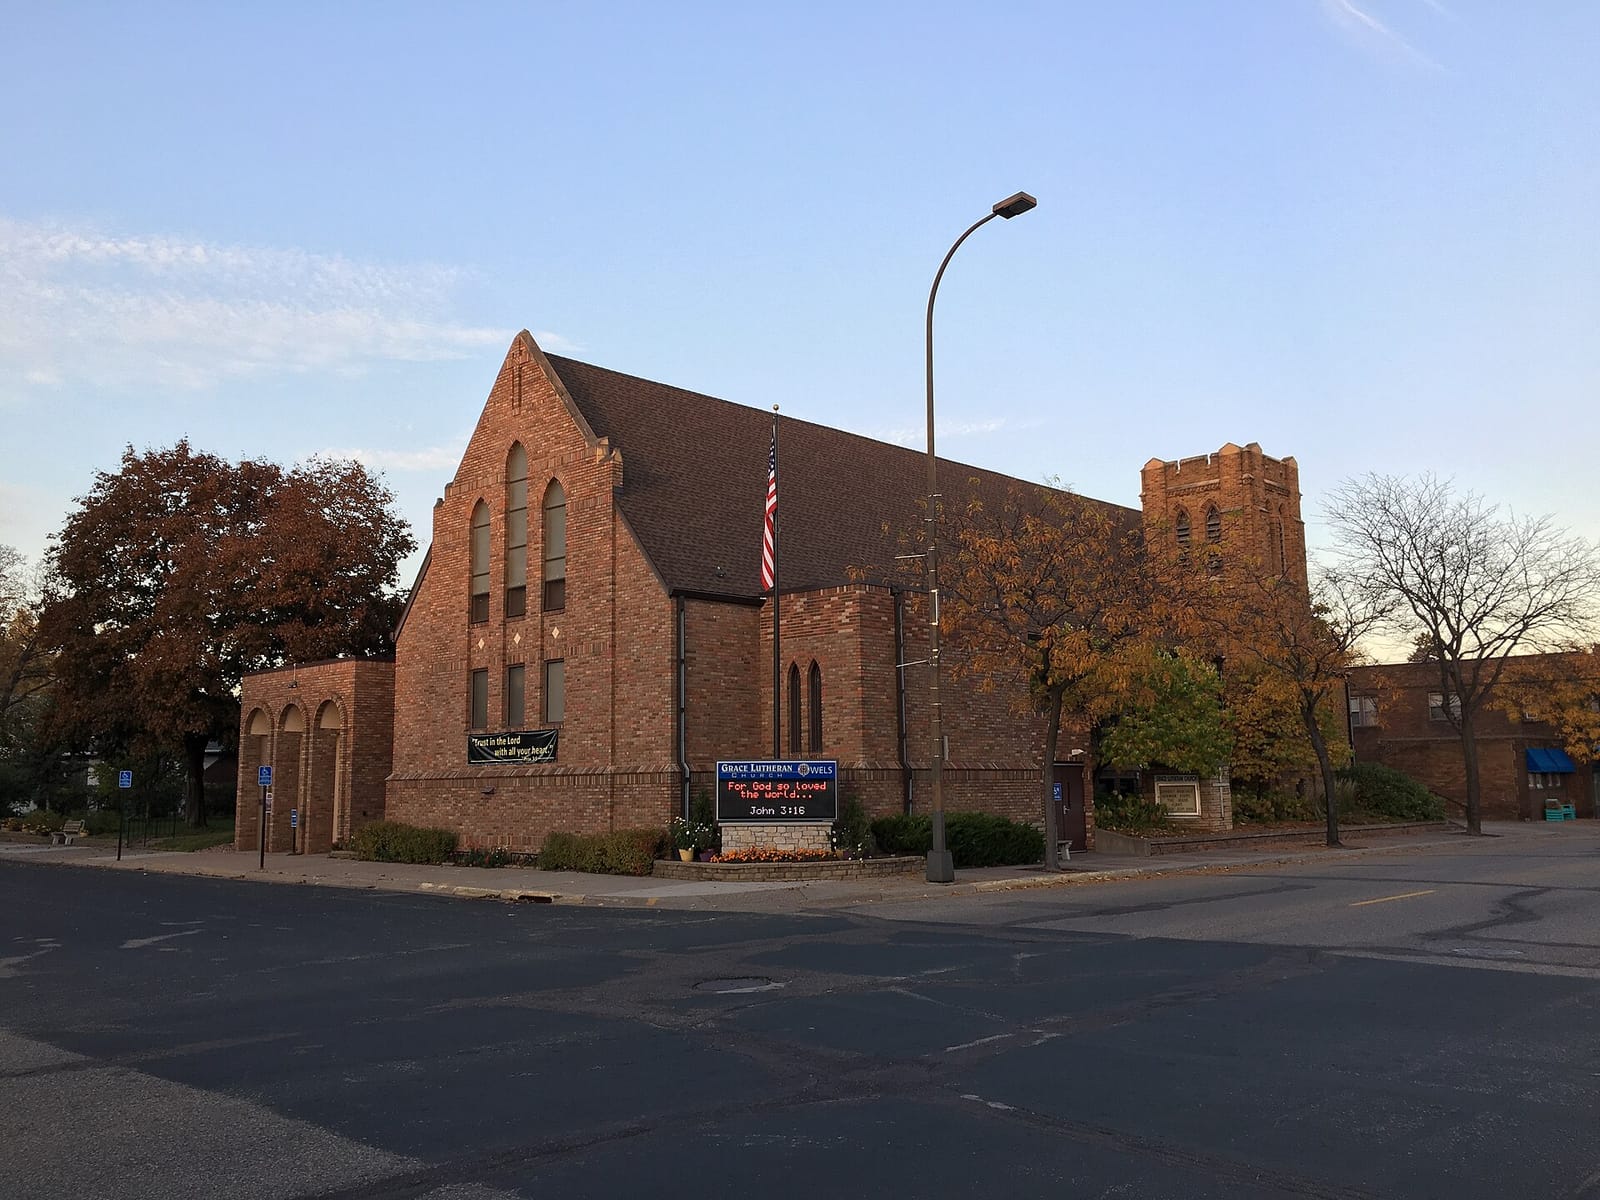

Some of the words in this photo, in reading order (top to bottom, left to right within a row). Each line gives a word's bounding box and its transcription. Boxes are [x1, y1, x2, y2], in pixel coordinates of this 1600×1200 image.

[496, 737, 507, 745] the
[507, 735, 521, 745] Lord
[508, 746, 516, 756] all
[516, 747, 531, 757] your
[721, 763, 748, 772] GRACE
[750, 763, 793, 772] LUTHERAN
[809, 766, 833, 774] WELS
[728, 781, 747, 791] For
[752, 781, 772, 791] God
[777, 783, 790, 791] so
[796, 781, 827, 790] loved
[740, 790, 760, 799] the
[764, 790, 813, 799] world...
[749, 806, 775, 815] John
[780, 806, 806, 815] 3:16
